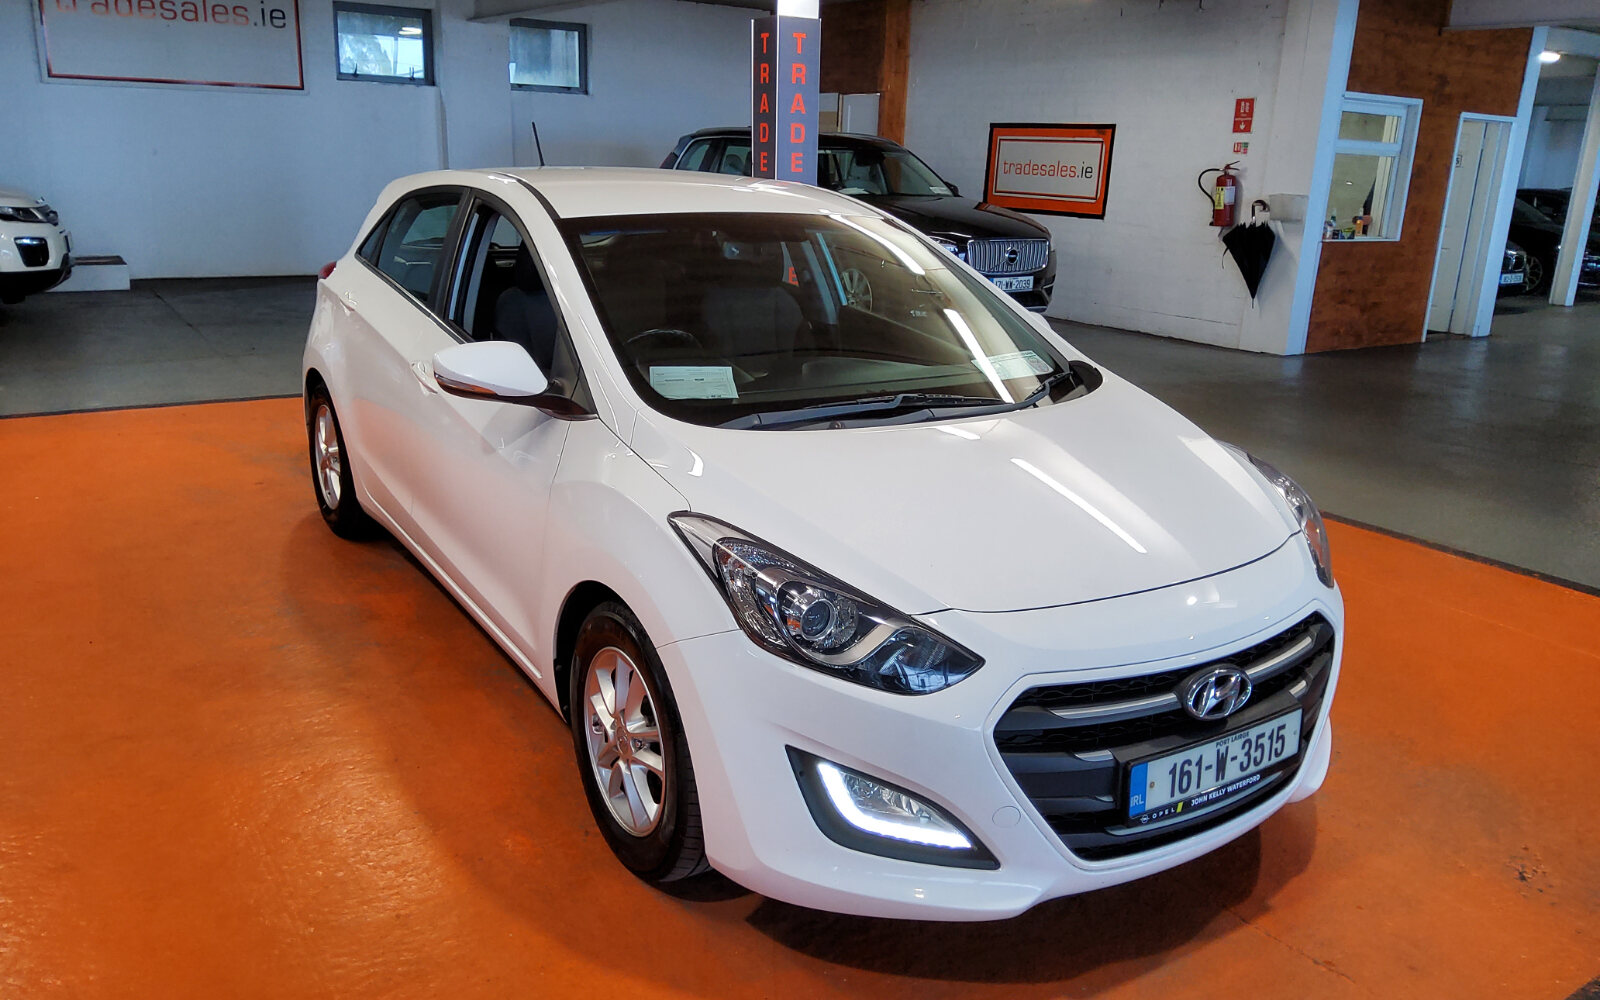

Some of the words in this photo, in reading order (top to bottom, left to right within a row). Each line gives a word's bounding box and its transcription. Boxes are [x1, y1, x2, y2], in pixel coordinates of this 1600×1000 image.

[760, 32, 770, 172] TRADE
[790, 32, 807, 173] TRADE
[1003, 160, 1093, 179] tradesales.ie
[1169, 723, 1287, 799] 161-W-3515
[1130, 794, 1145, 808] IRL
[1190, 794, 1208, 807] JOHN
[1208, 787, 1227, 800] KELLY
[1227, 774, 1261, 793] WATERFORD
[1152, 807, 1176, 819] OPEL
